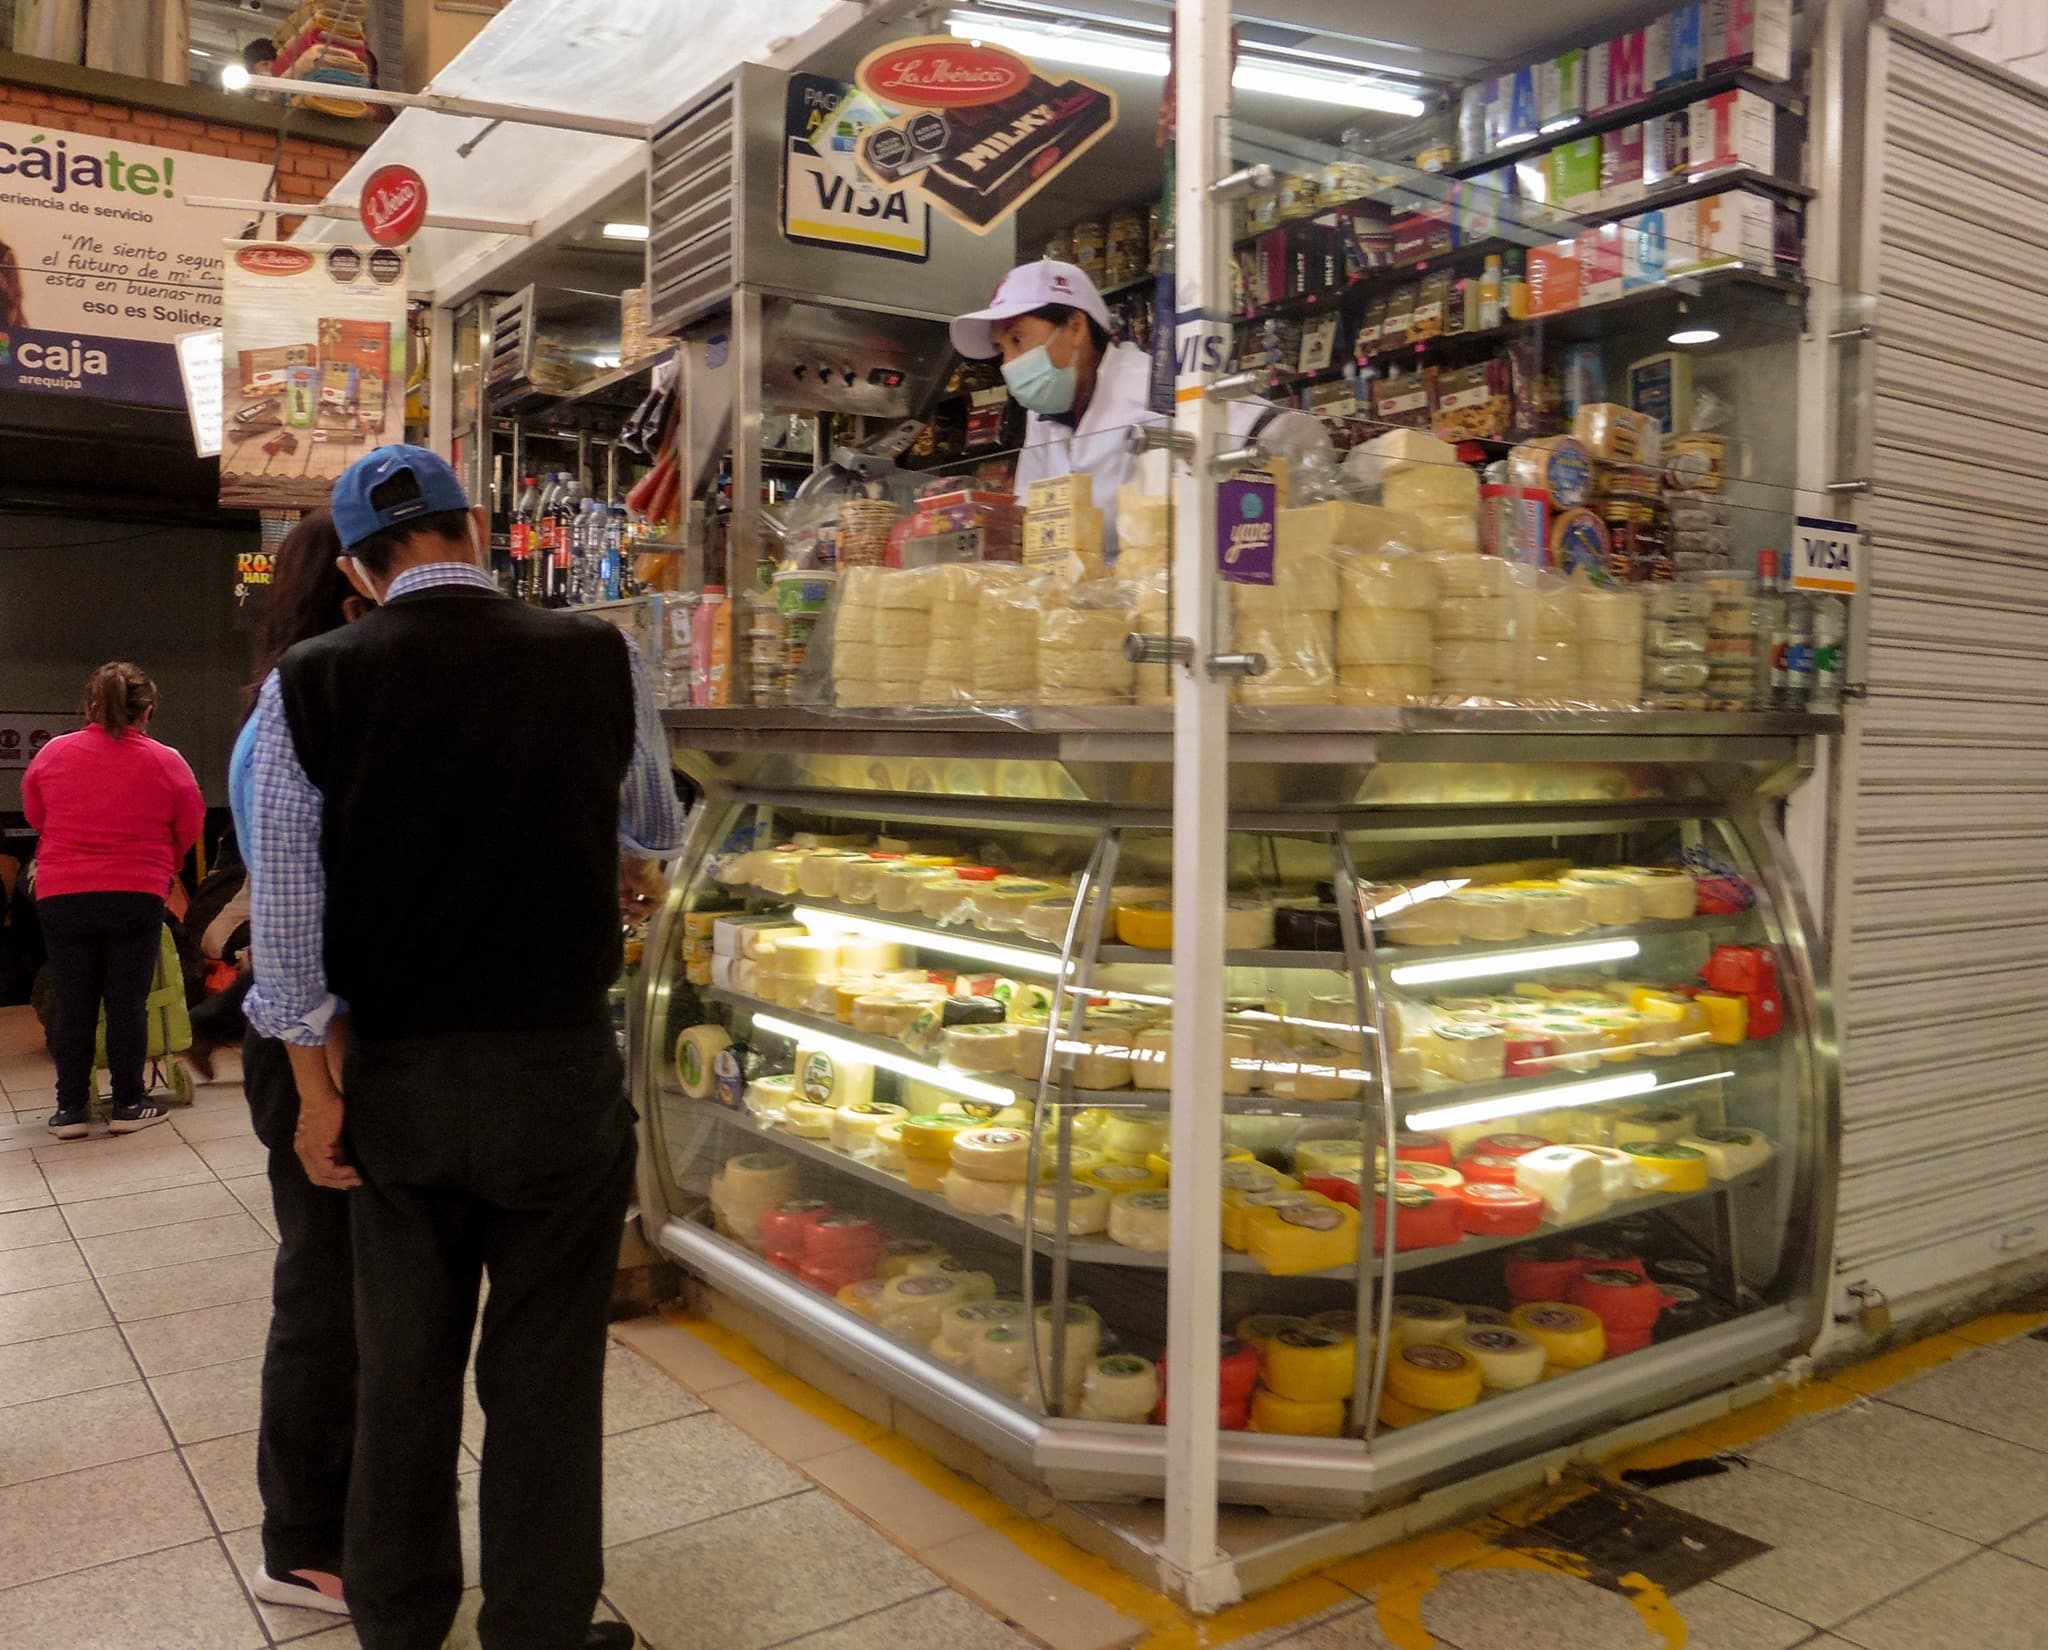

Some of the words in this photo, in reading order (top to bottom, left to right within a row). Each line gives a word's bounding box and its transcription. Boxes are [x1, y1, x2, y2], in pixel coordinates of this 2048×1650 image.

[882, 59, 919, 87] La
[70, 200, 89, 214] de
[94, 206, 153, 223] servicio
[113, 243, 167, 262] siento
[42, 251, 59, 266] el
[68, 254, 129, 275] futuro
[138, 263, 159, 279] de
[96, 281, 117, 293] en
[127, 280, 188, 300] buenas
[83, 301, 118, 315] eso
[125, 304, 147, 318] es
[17, 340, 108, 378] caja
[19, 374, 82, 389] arequipa
[1801, 537, 1851, 571] VISA
